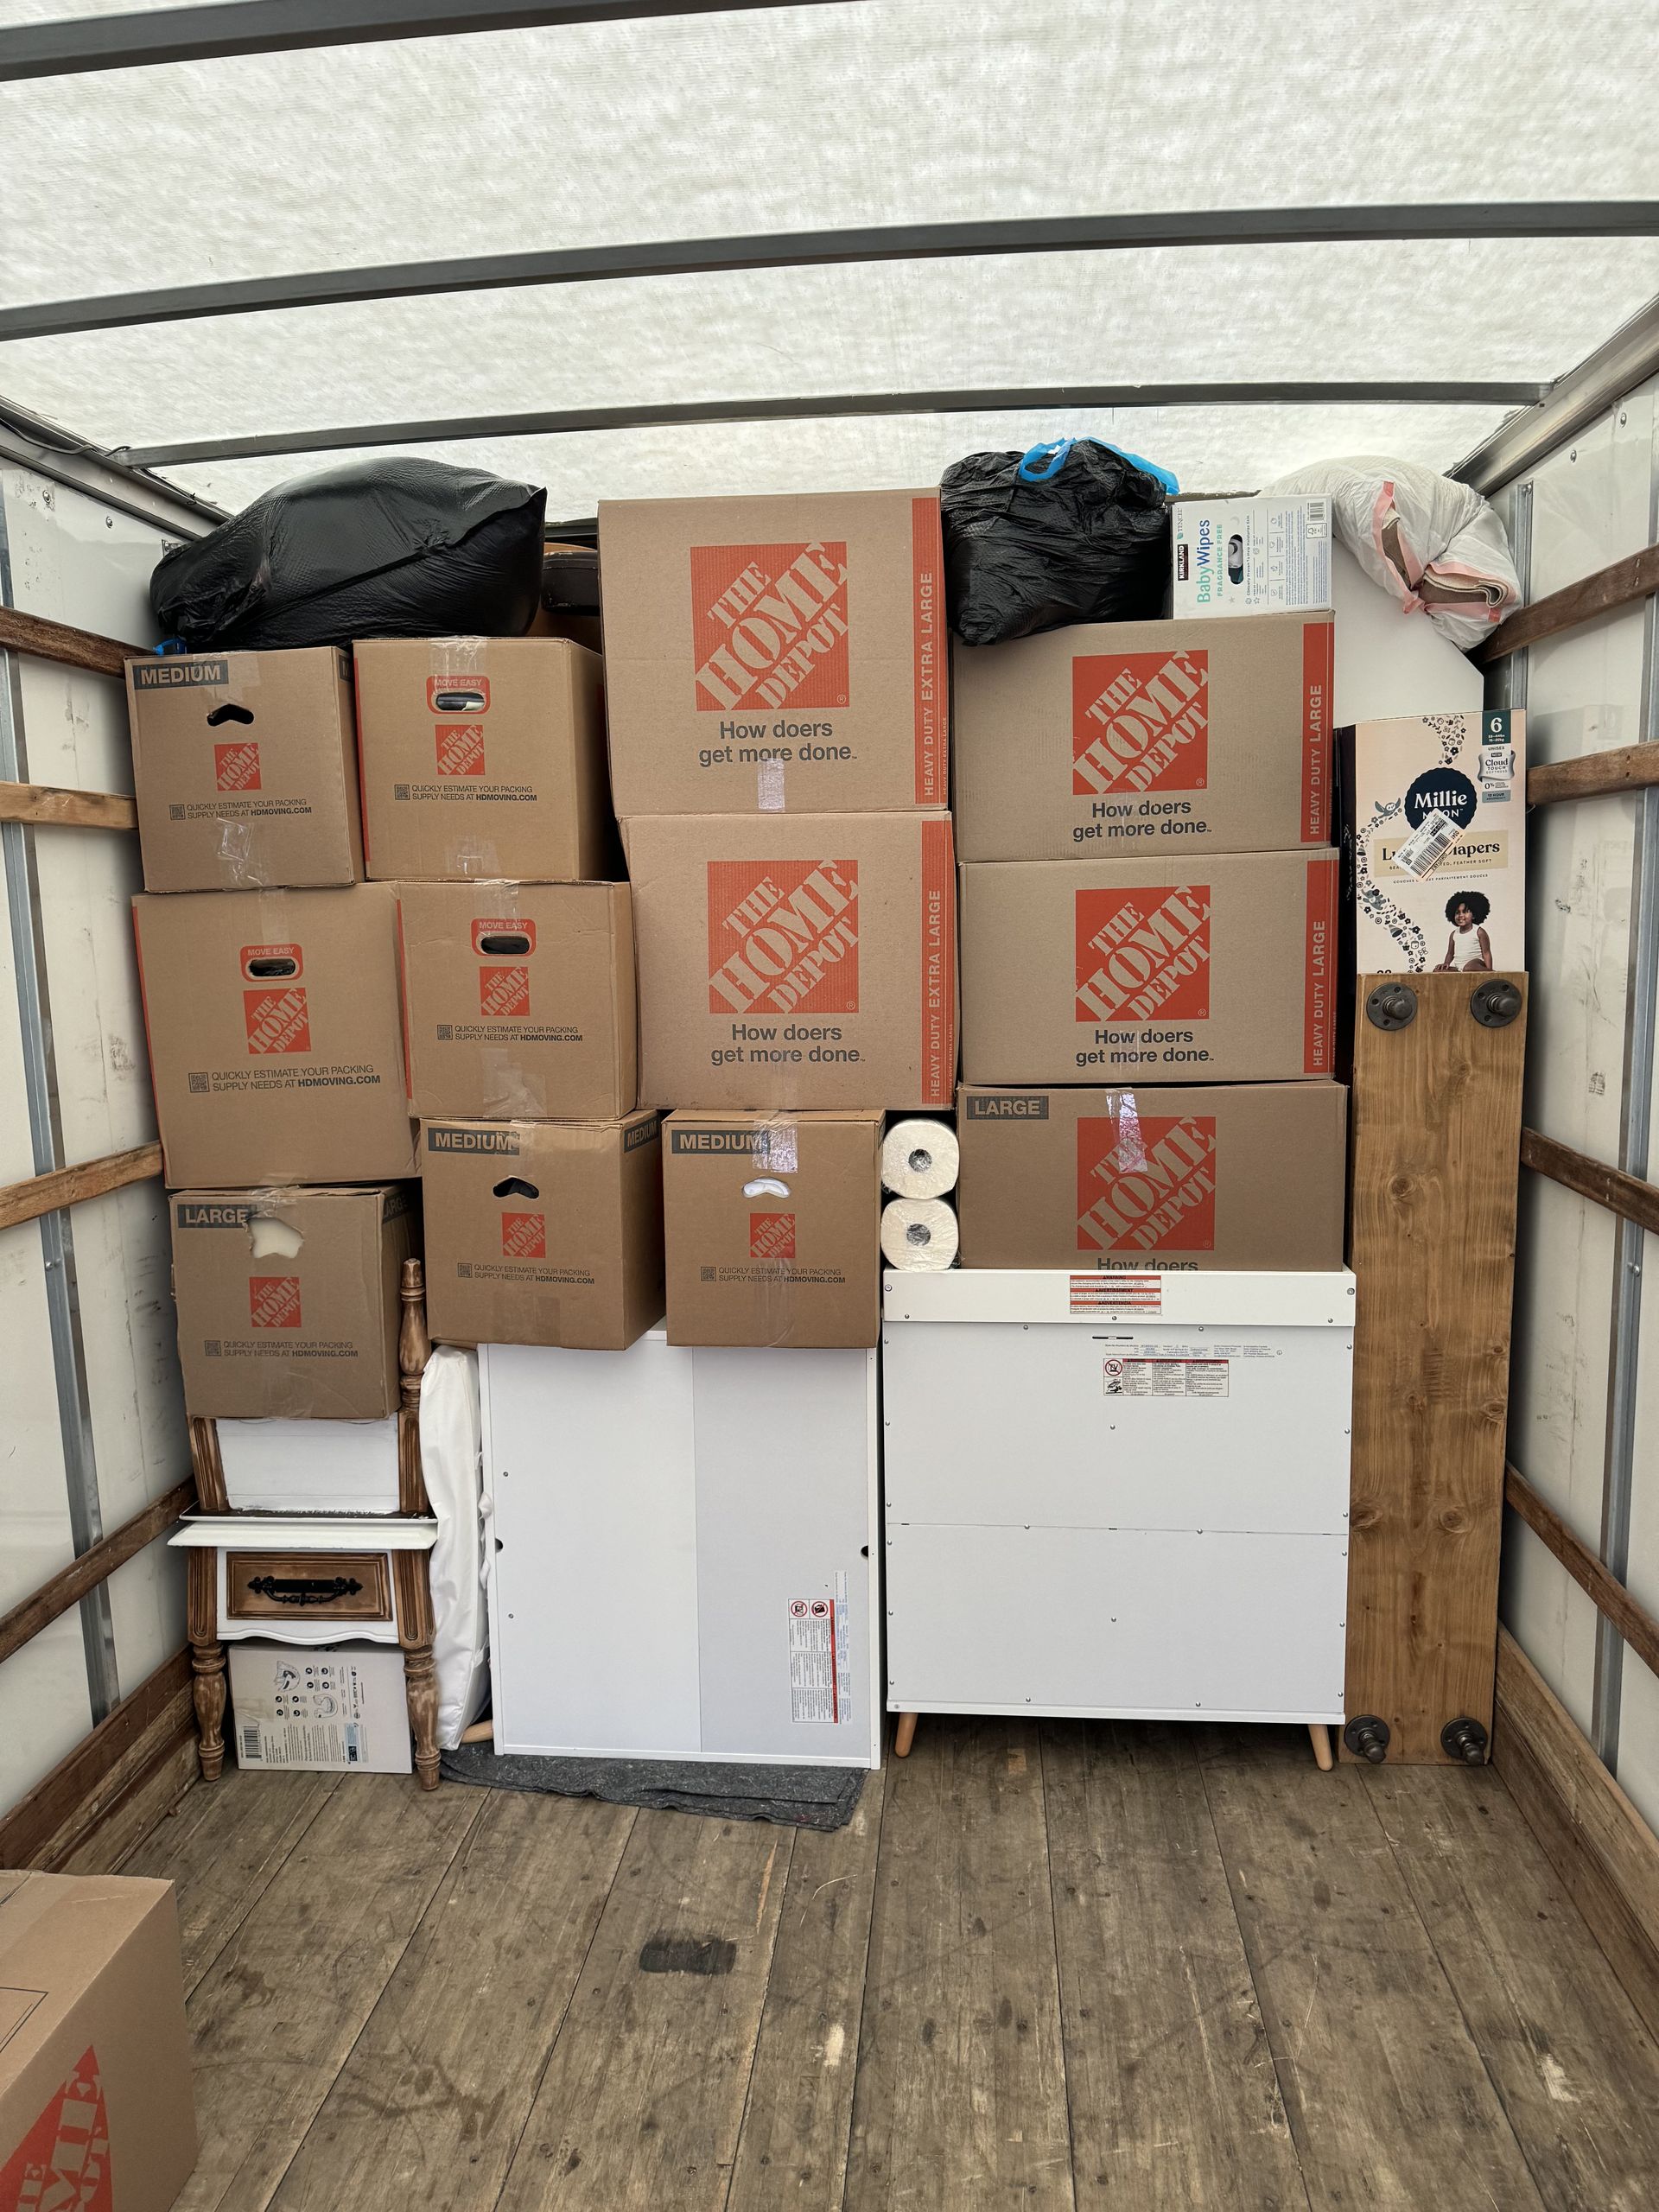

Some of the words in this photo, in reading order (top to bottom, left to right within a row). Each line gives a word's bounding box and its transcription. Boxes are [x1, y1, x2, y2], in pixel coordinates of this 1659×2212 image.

[707, 562, 772, 629] THE
[920, 572, 933, 636] LARGE
[696, 542, 848, 710] HOME
[756, 602, 849, 709] DEPOT
[920, 645, 933, 701] EXTRA
[140, 664, 221, 685] MEDIUM
[1085, 668, 1142, 725] THE
[1309, 685, 1322, 743] LARGE
[441, 730, 461, 749] THE
[720, 721, 766, 740] How
[772, 720, 833, 738] doers
[924, 709, 934, 745] DUTY
[1073, 651, 1209, 794] HOME
[1491, 717, 1503, 733] 6
[221, 748, 237, 767] THE
[437, 725, 484, 775] HOME
[455, 743, 485, 775] DEPOT
[699, 745, 733, 767] get
[739, 746, 792, 762] more
[1126, 702, 1210, 792] DEPOT
[217, 743, 259, 791] HOME
[235, 762, 259, 791] DEPOT
[924, 748, 934, 797] HEAVY
[1310, 752, 1320, 788] DUTY
[1092, 802, 1133, 818] How
[1139, 800, 1192, 816] doers
[1309, 794, 1319, 836] HEAVY
[1414, 791, 1467, 809] Millie
[1073, 823, 1103, 842] get
[1108, 821, 1155, 839] more
[721, 876, 785, 938] THE
[928, 890, 941, 947] LARGE
[709, 860, 859, 1014] HOME
[1088, 902, 1145, 957] THE
[767, 917, 859, 1014] DEPOT
[1076, 886, 1210, 1021] HOME
[1313, 920, 1325, 976] LARGE
[481, 967, 528, 1016] HOME
[485, 971, 505, 991] THE
[928, 953, 941, 1007] EXTRA
[1128, 935, 1210, 1020] DEPOT
[251, 995, 276, 1021] THE
[501, 985, 529, 1016] DEPOT
[1313, 981, 1323, 1018] DUTY
[248, 988, 308, 1053] HOME
[273, 1012, 308, 1052] DEPOT
[732, 1023, 777, 1040] How
[783, 1023, 842, 1040] doers
[930, 1014, 939, 1049] DUTY
[1096, 1029, 1135, 1044] How
[1141, 1028, 1193, 1043] doers
[711, 1047, 743, 1066] get
[750, 1047, 803, 1062] more
[1076, 1049, 1105, 1066] get
[1110, 1048, 1157, 1063] more
[1313, 1024, 1323, 1066] HEAVY
[212, 1071, 251, 1081] QUICKLY
[253, 1069, 298, 1078] ESTIMATE
[301, 1067, 328, 1077] YOUR
[331, 1065, 374, 1074] PACKING
[213, 1082, 250, 1091] SUPPLY
[251, 1080, 283, 1089] NEEDS
[284, 1079, 296, 1088] AT
[298, 1075, 380, 1088] HDMOVING.COM
[930, 1052, 939, 1096] HEAVY
[975, 1100, 1040, 1116] LARGE
[435, 1132, 512, 1151] MEDIUM
[1077, 1116, 1216, 1250] HOME
[185, 1209, 249, 1224] LARGE
[1131, 1166, 1216, 1249] DEPOT
[503, 1214, 544, 1257] HOME
[507, 1217, 524, 1235] THE
[521, 1230, 545, 1258] DEPOT
[750, 1213, 795, 1258] HOME
[753, 1217, 773, 1236] THE
[768, 1231, 796, 1258] DEPOT
[474, 1264, 503, 1273] QUICKLY
[504, 1266, 537, 1274] ESTIMATE
[474, 1271, 500, 1280] SUPPLY
[535, 1274, 594, 1284] HDMOVING.COM
[1097, 1257, 1139, 1270] How
[1144, 1257, 1198, 1270] doers
[251, 1277, 300, 1327] HOME
[255, 1283, 275, 1303] THE
[270, 1297, 300, 1327] DEPOT
